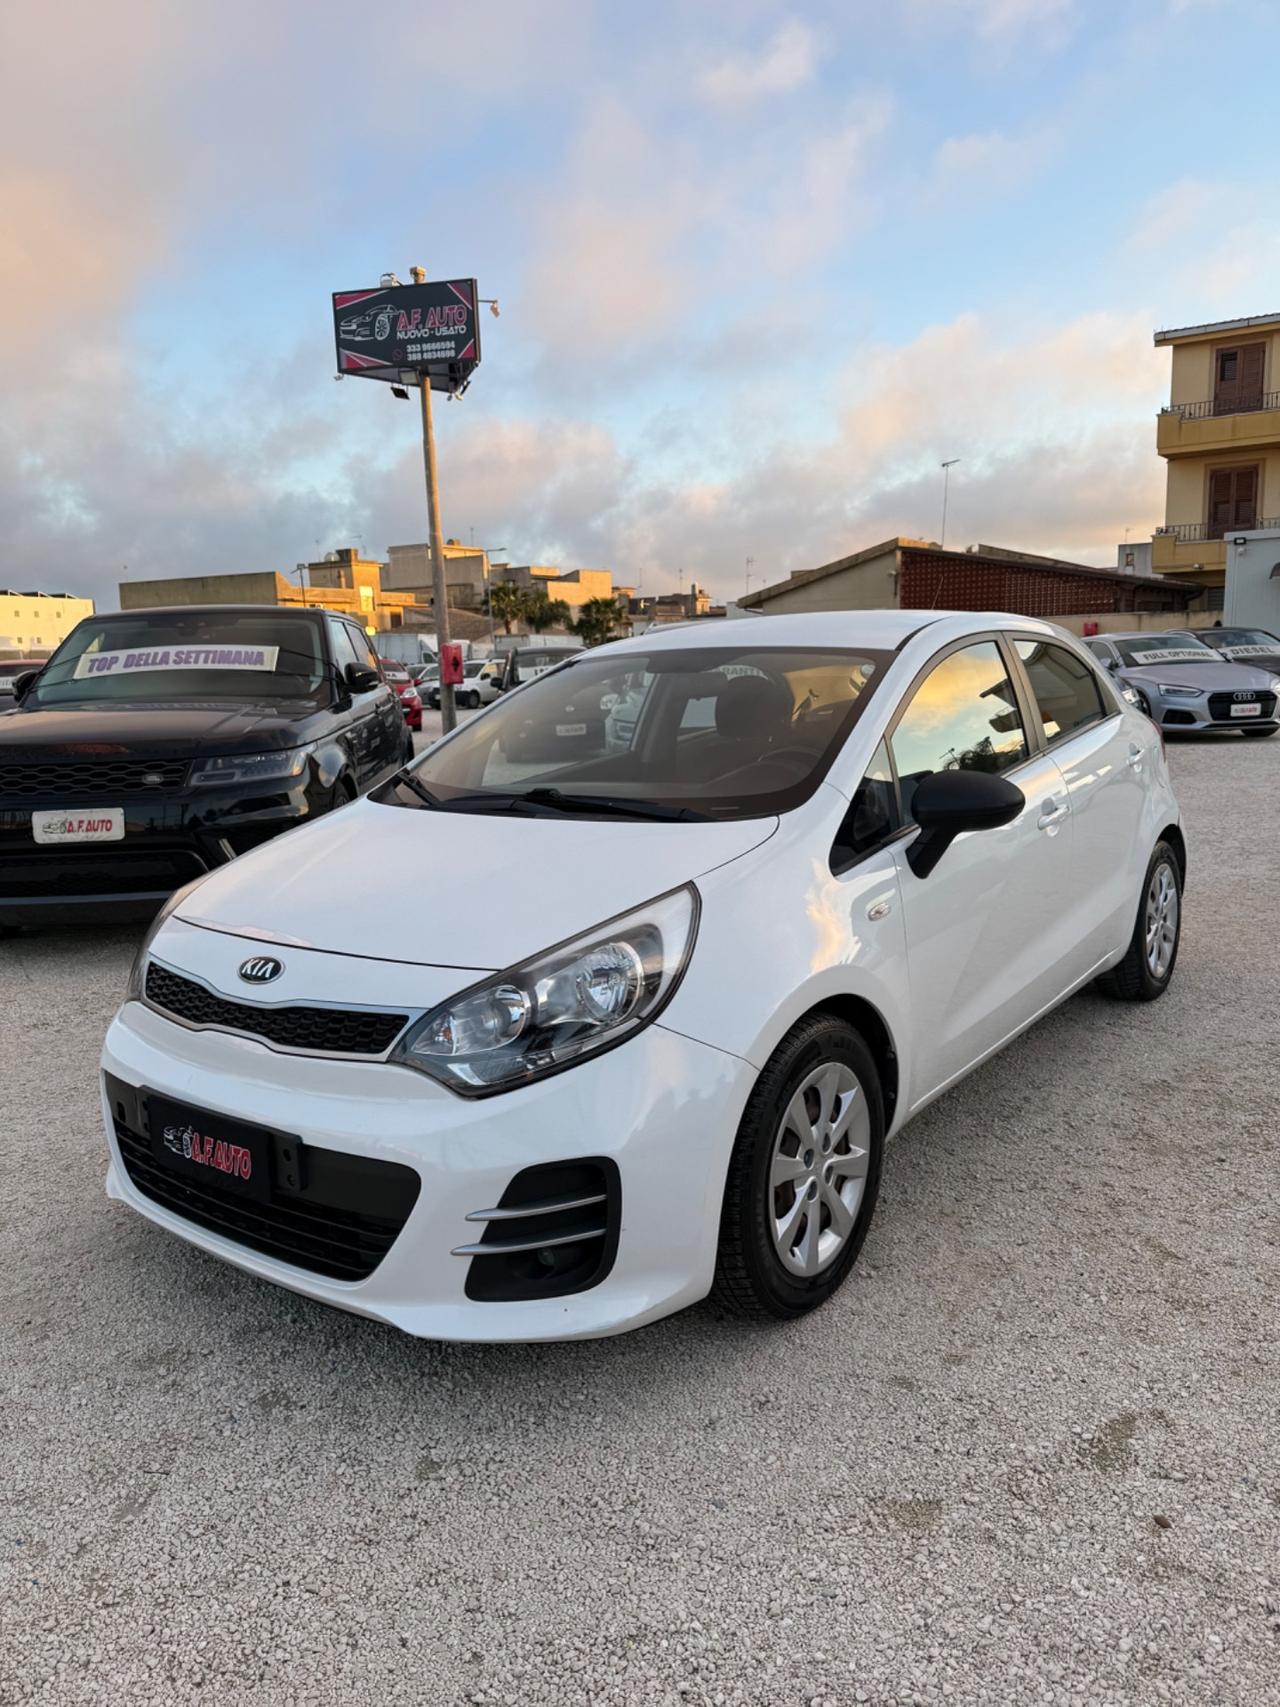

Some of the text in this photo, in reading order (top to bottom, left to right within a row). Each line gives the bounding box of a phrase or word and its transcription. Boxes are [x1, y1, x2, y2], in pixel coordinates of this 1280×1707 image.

[426, 304, 467, 328] AUTO
[397, 328, 430, 340] NUOVO
[435, 325, 467, 336] USATO
[1230, 646, 1275, 655] DIESEL
[88, 650, 264, 673] TOP DELLA SETTIMANA
[241, 959, 275, 978] KIA
